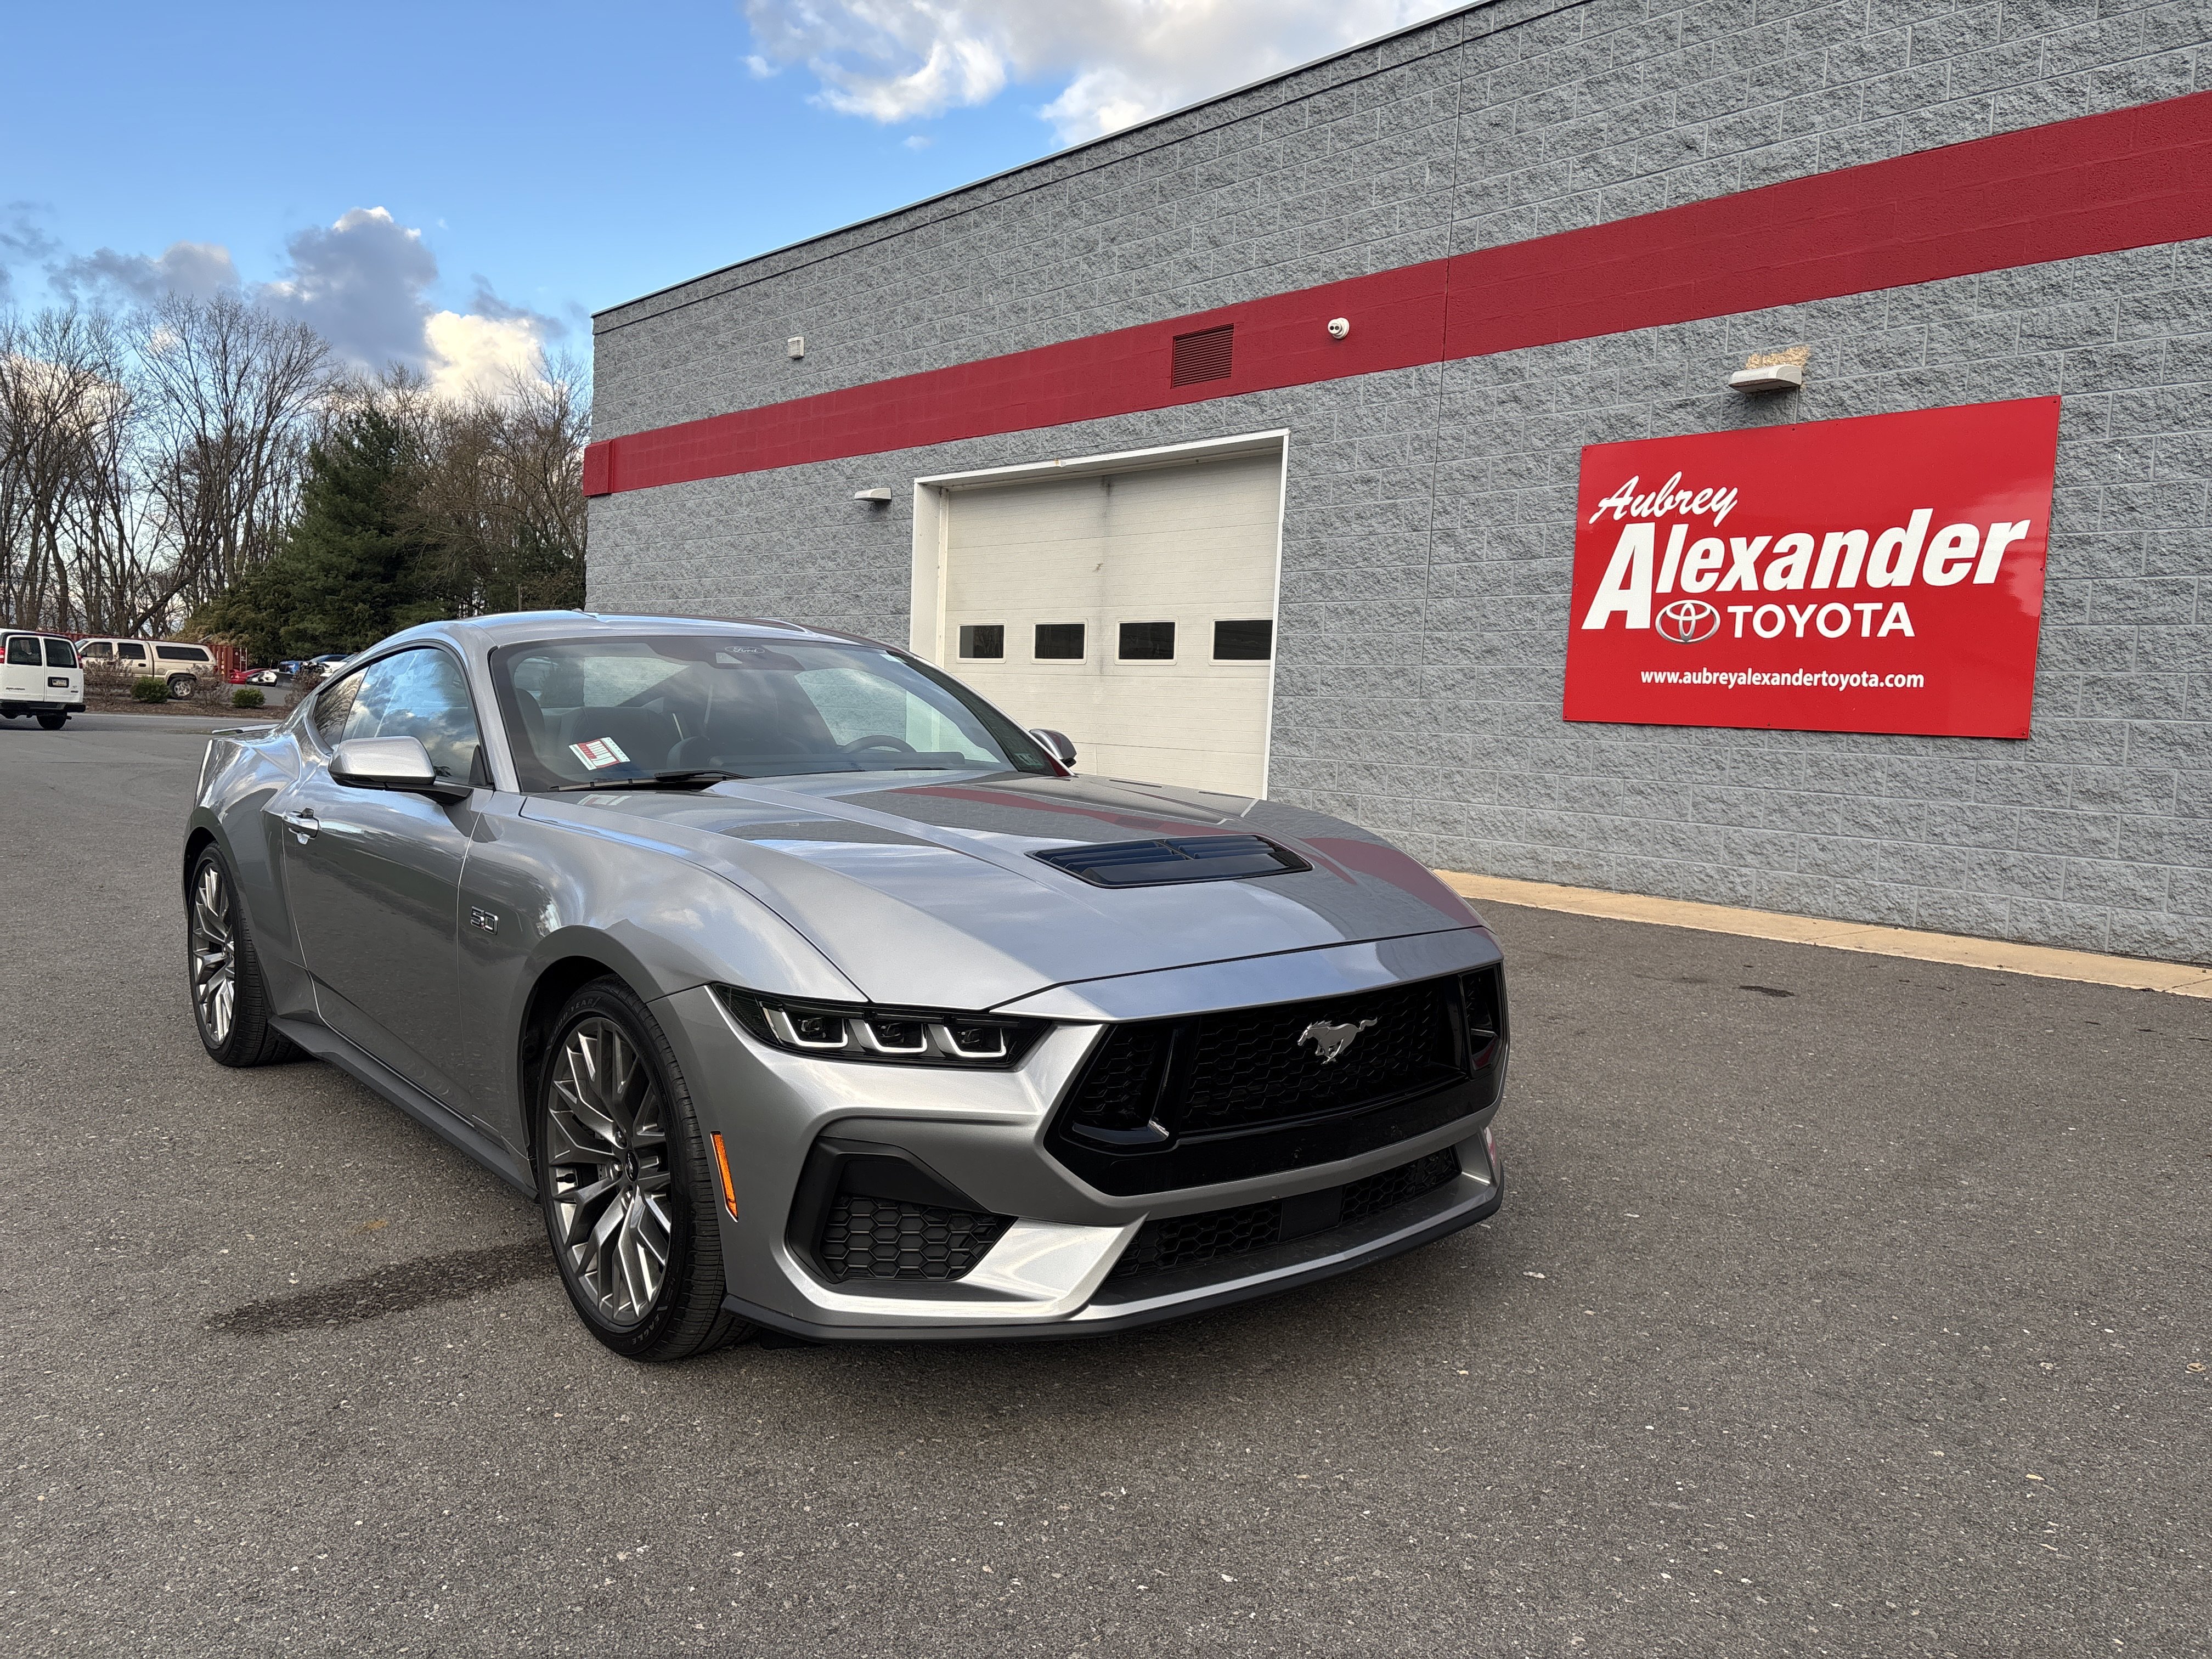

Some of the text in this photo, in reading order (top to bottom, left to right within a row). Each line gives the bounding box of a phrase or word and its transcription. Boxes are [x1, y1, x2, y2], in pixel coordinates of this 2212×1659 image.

[1588, 471, 1738, 527] Aubrey
[1581, 508, 2031, 630] Alexander
[1727, 602, 1915, 639] TOYOTA
[1641, 667, 1924, 692] www.aubreyalexandertoyota.com
[631, 1313, 660, 1345] EAGLE
